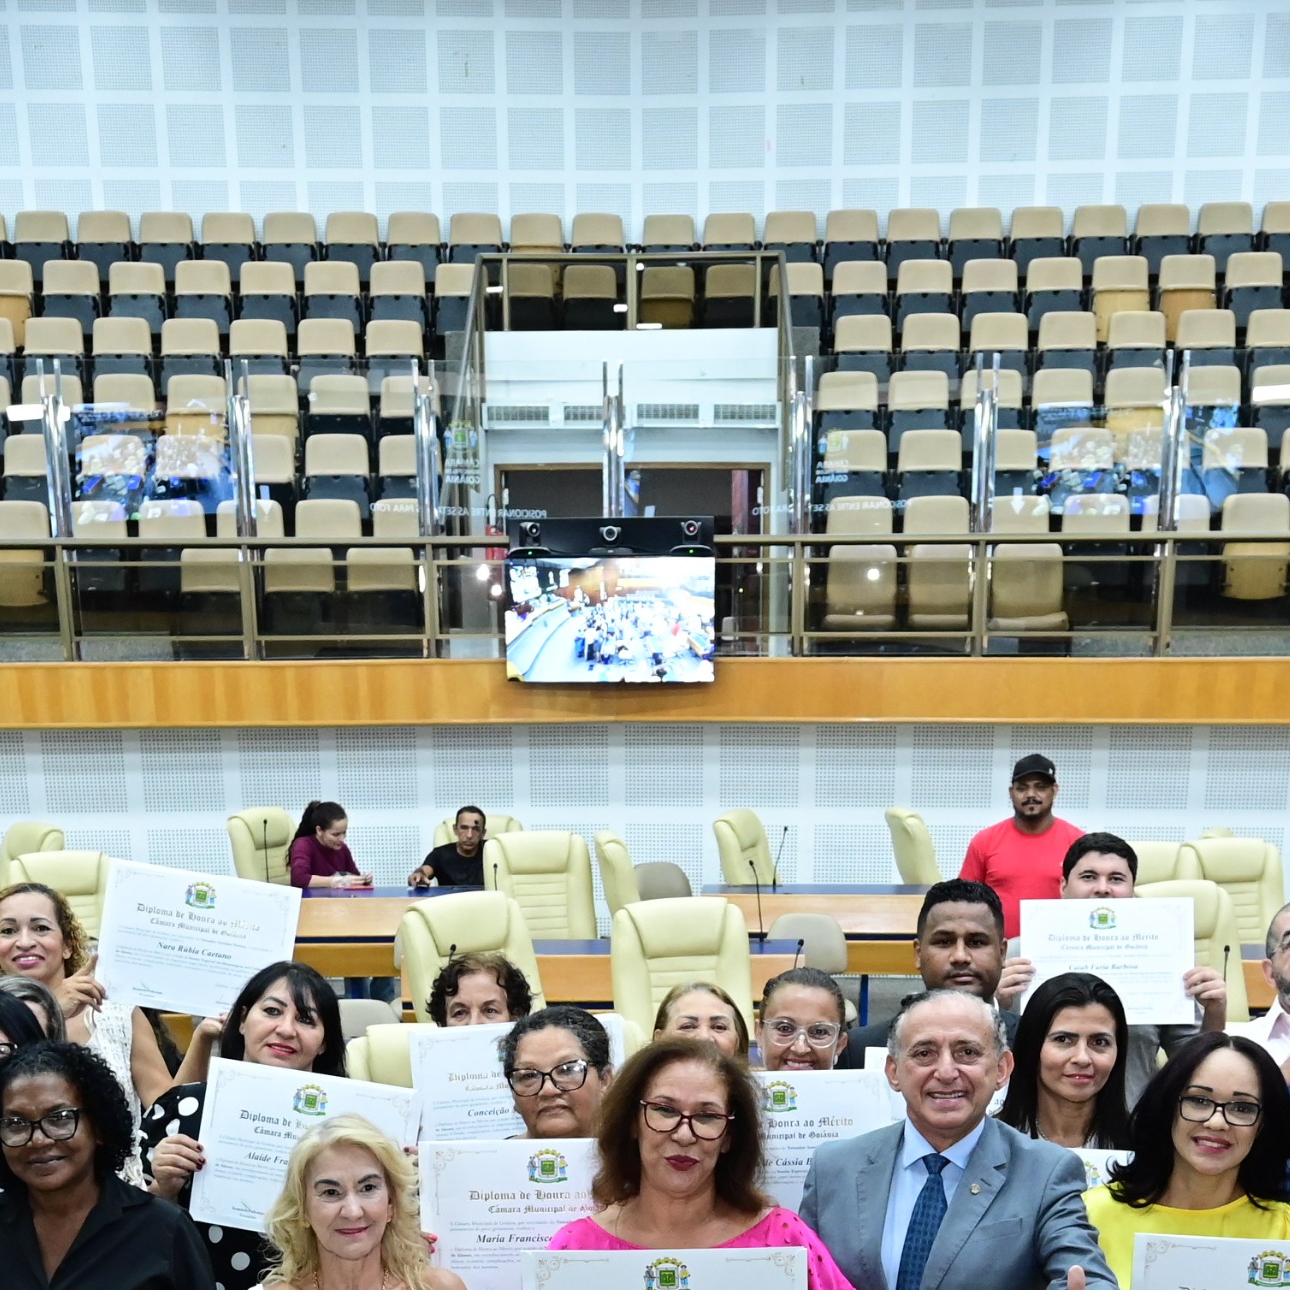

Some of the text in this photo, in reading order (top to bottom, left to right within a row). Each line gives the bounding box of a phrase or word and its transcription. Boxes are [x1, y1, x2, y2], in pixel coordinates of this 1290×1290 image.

[467, 1107, 509, 1116] Conceição
[245, 1152, 271, 1162] Alaíde
[775, 1158, 803, 1166] Cássia
[476, 1235, 505, 1243] Maria
